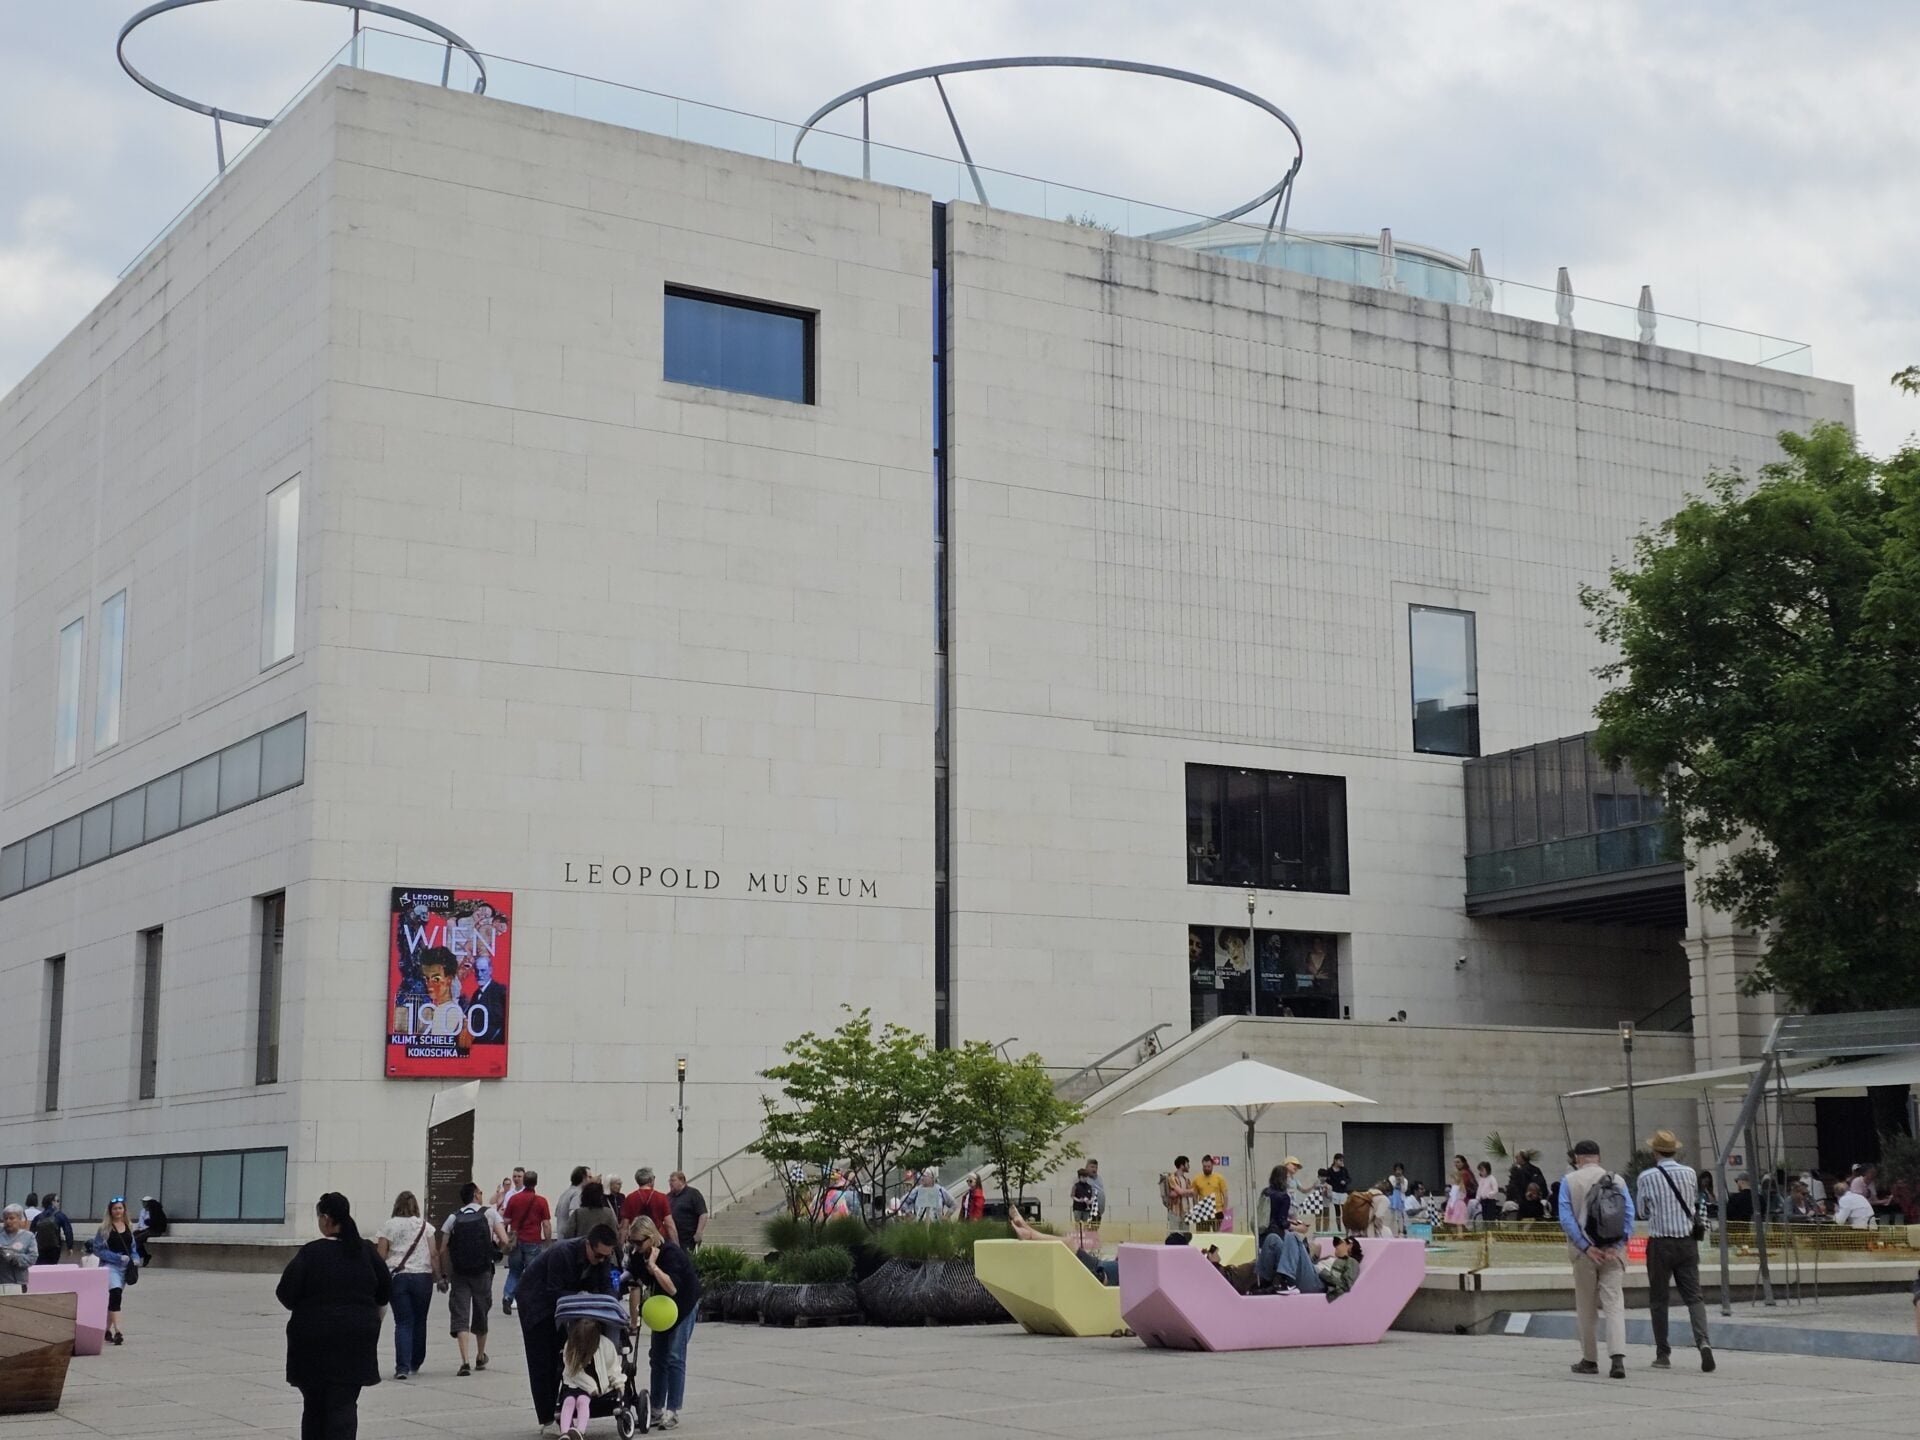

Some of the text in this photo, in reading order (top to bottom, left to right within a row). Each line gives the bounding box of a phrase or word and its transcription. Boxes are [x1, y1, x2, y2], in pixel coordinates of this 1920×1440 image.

[564, 862, 878, 898] LEOPOLD MUSEUM
[412, 893, 449, 902] LEOPOLD
[412, 900, 449, 909] MUSEUM
[403, 924, 496, 957] WIEN
[404, 1002, 489, 1037] 1900
[391, 1034, 457, 1047] KLIMT, SCHIELE,
[408, 1047, 459, 1058] KOKOSCHKA
